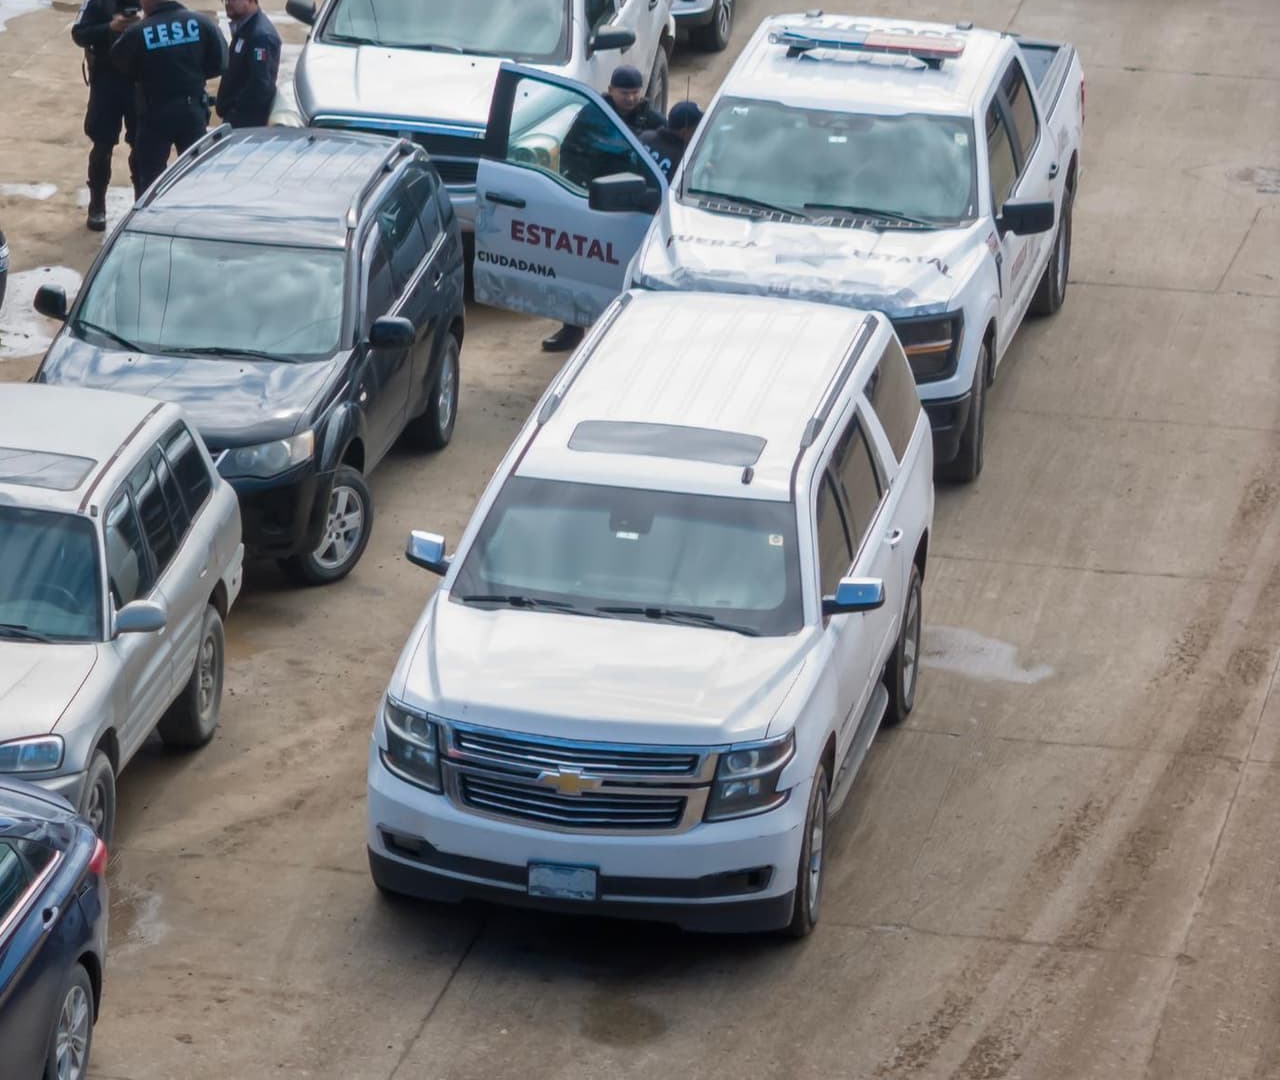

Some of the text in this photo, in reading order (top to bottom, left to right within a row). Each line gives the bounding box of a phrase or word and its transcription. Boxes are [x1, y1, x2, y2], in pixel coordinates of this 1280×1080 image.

[143, 19, 200, 48] FESC
[511, 220, 619, 265] ESTATAL
[666, 234, 758, 249] FUERZA
[478, 250, 556, 278] CIUDADANA
